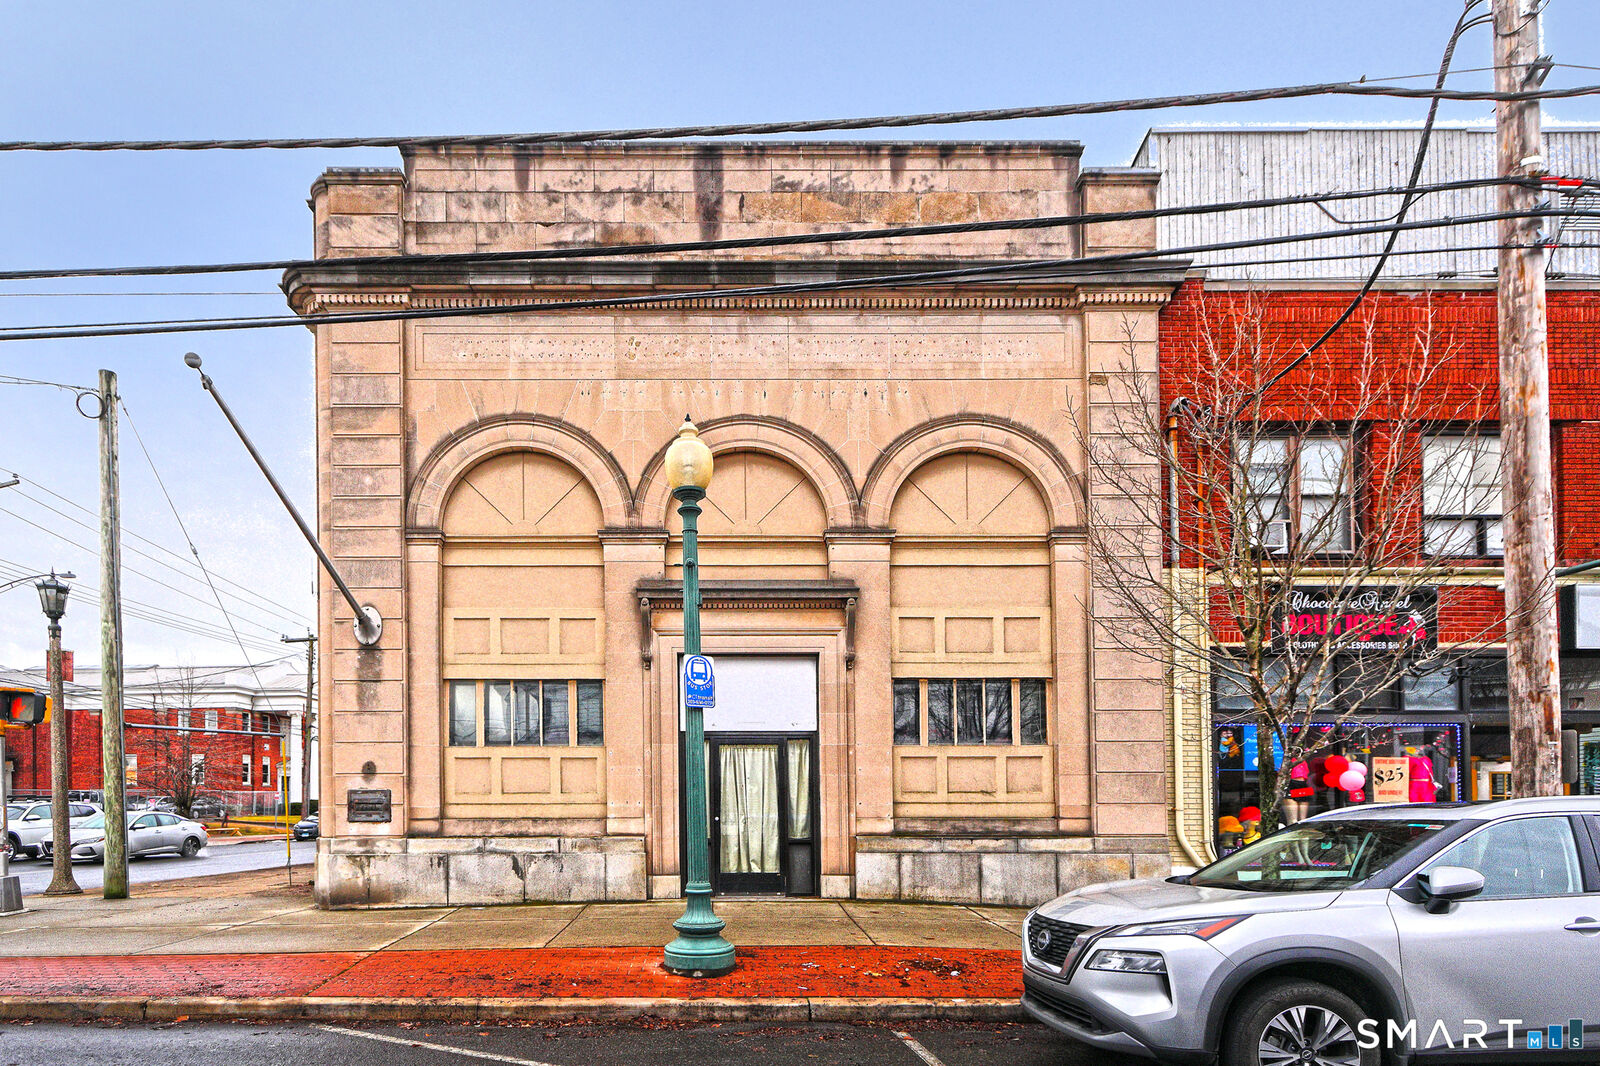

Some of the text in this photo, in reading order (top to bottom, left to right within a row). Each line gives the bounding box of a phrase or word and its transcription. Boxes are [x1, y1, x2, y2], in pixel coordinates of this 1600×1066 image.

[1286, 590, 1412, 612] Chocoe Anel
[687, 680, 712, 691] BUS STOP
[1374, 767, 1404, 787] $25
